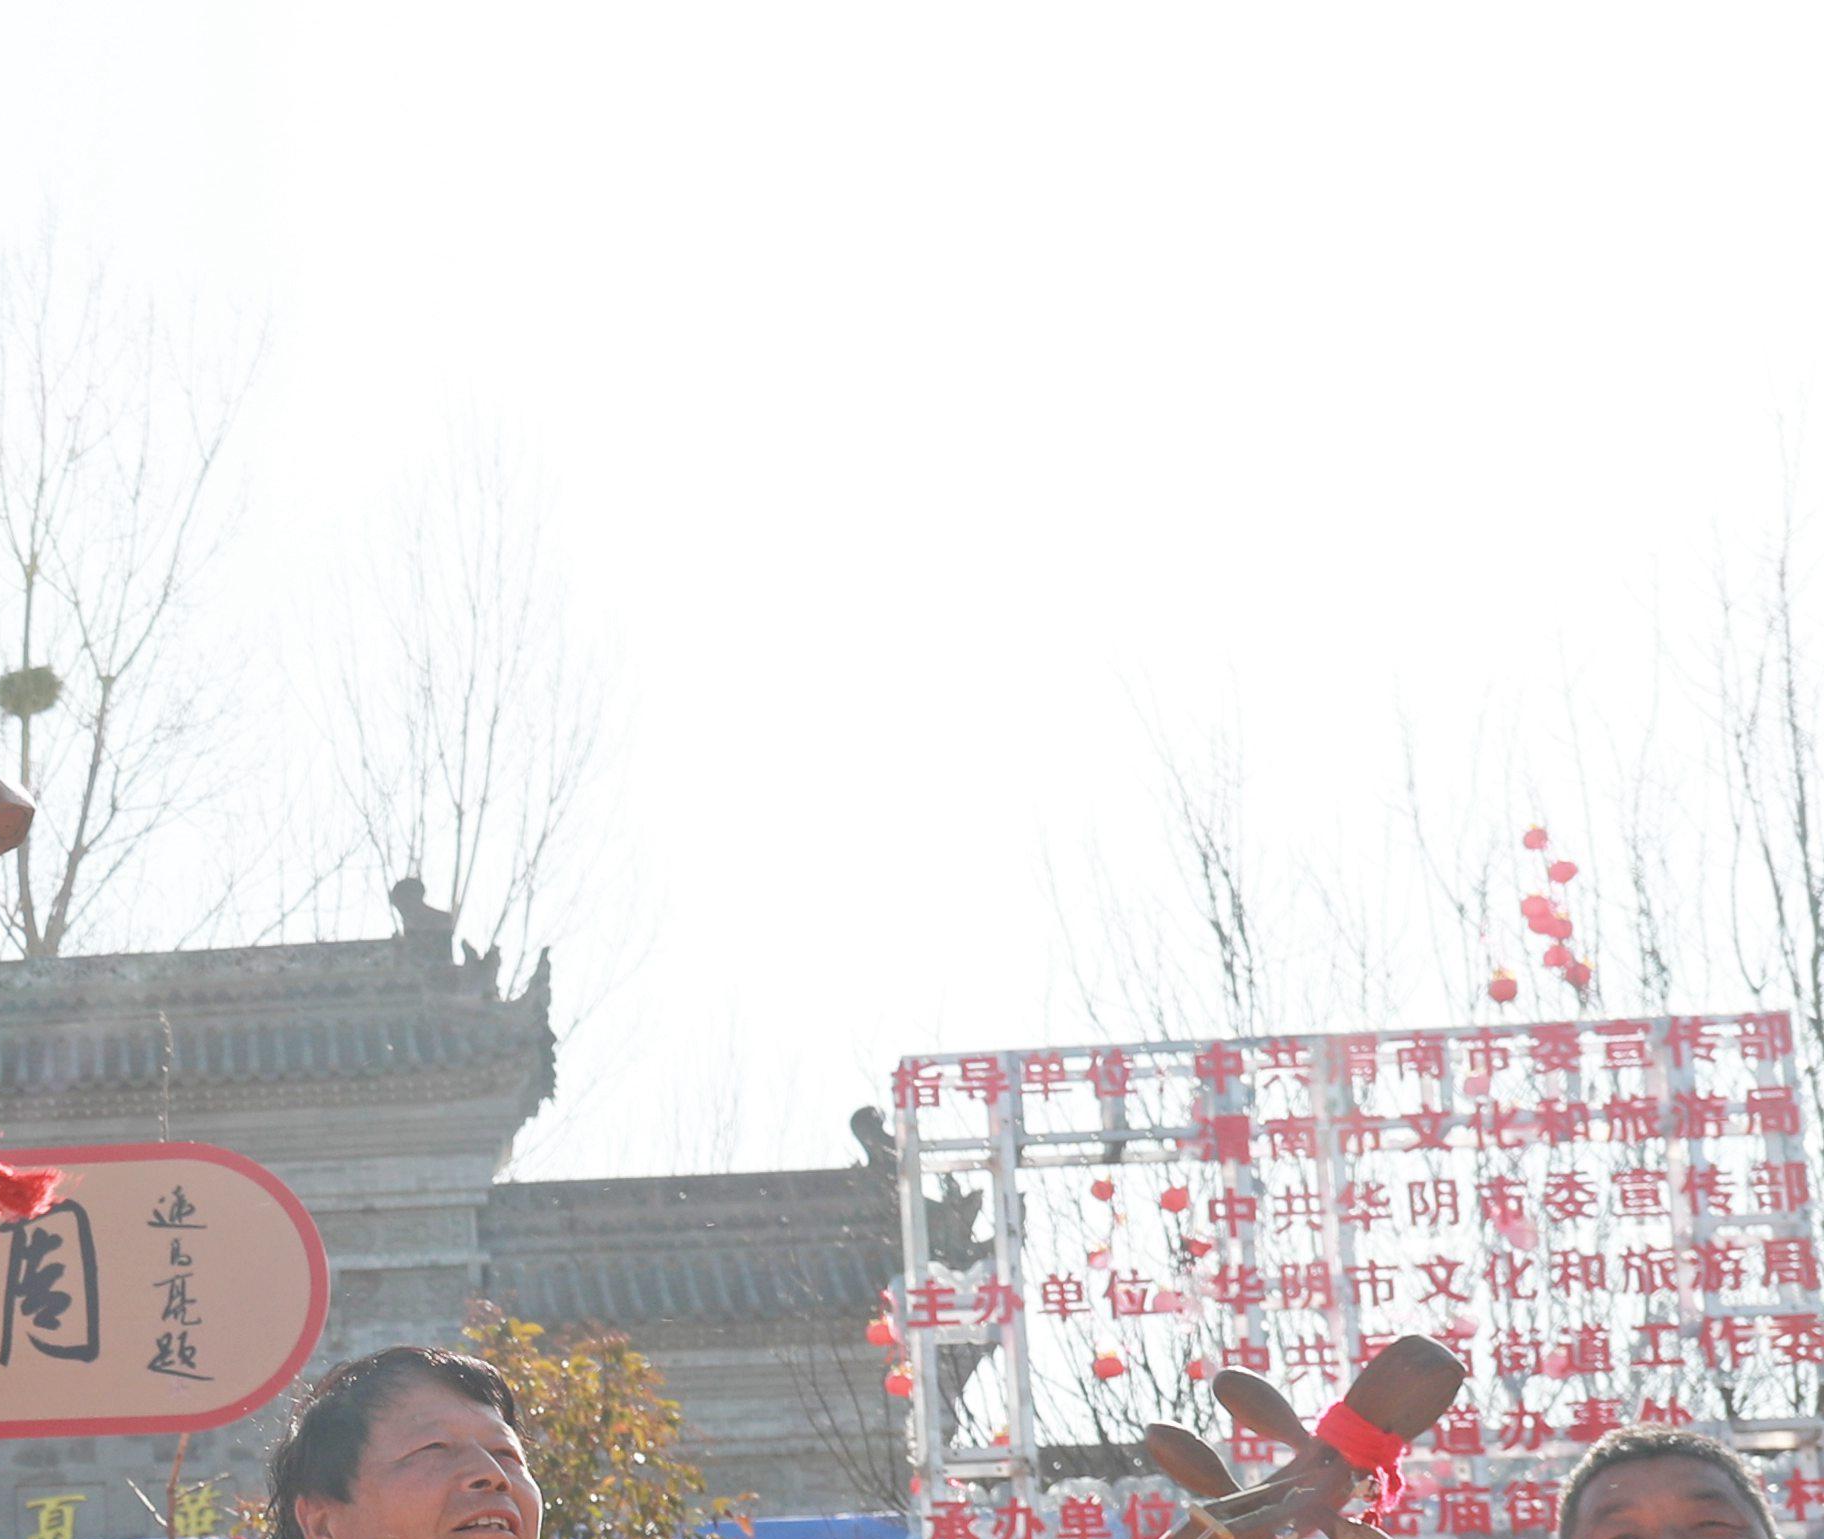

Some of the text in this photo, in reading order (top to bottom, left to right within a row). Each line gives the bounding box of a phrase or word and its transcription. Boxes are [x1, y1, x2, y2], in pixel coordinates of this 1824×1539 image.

[1222, 1313, 1824, 1384] 中共街道工作委
